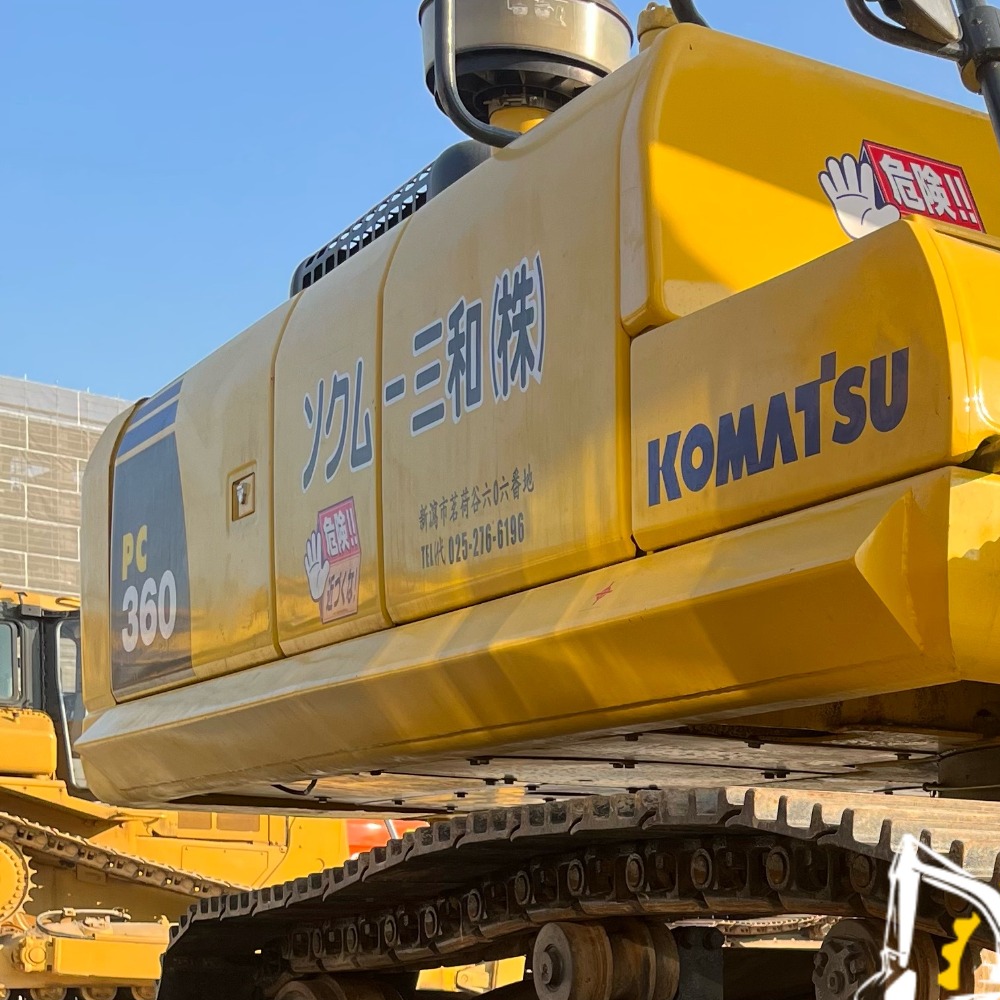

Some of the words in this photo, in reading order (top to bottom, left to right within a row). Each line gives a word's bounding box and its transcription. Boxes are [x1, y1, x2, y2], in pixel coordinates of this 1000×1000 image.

[648, 346, 910, 507] KOMATSU
[122, 524, 148, 582] PC
[448, 512, 525, 565] 025-276-6196
[121, 569, 177, 653] 360
